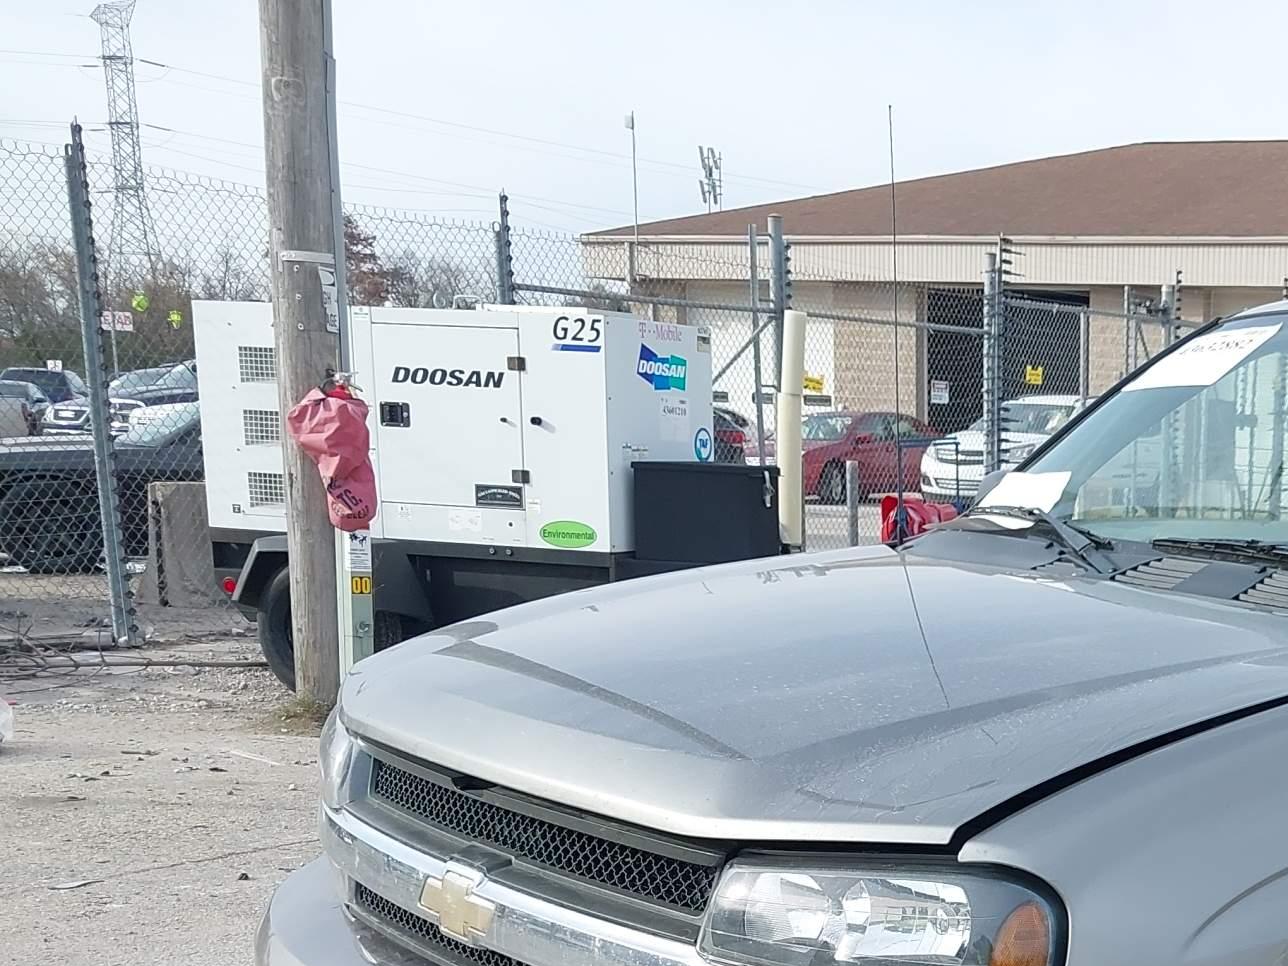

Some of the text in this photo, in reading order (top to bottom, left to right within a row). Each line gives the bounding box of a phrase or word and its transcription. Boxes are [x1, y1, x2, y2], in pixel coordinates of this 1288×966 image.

[553, 316, 602, 343] G25
[391, 366, 504, 388] DOOSAN
[638, 360, 686, 379] DOOSAN
[542, 528, 595, 541] Environmental
